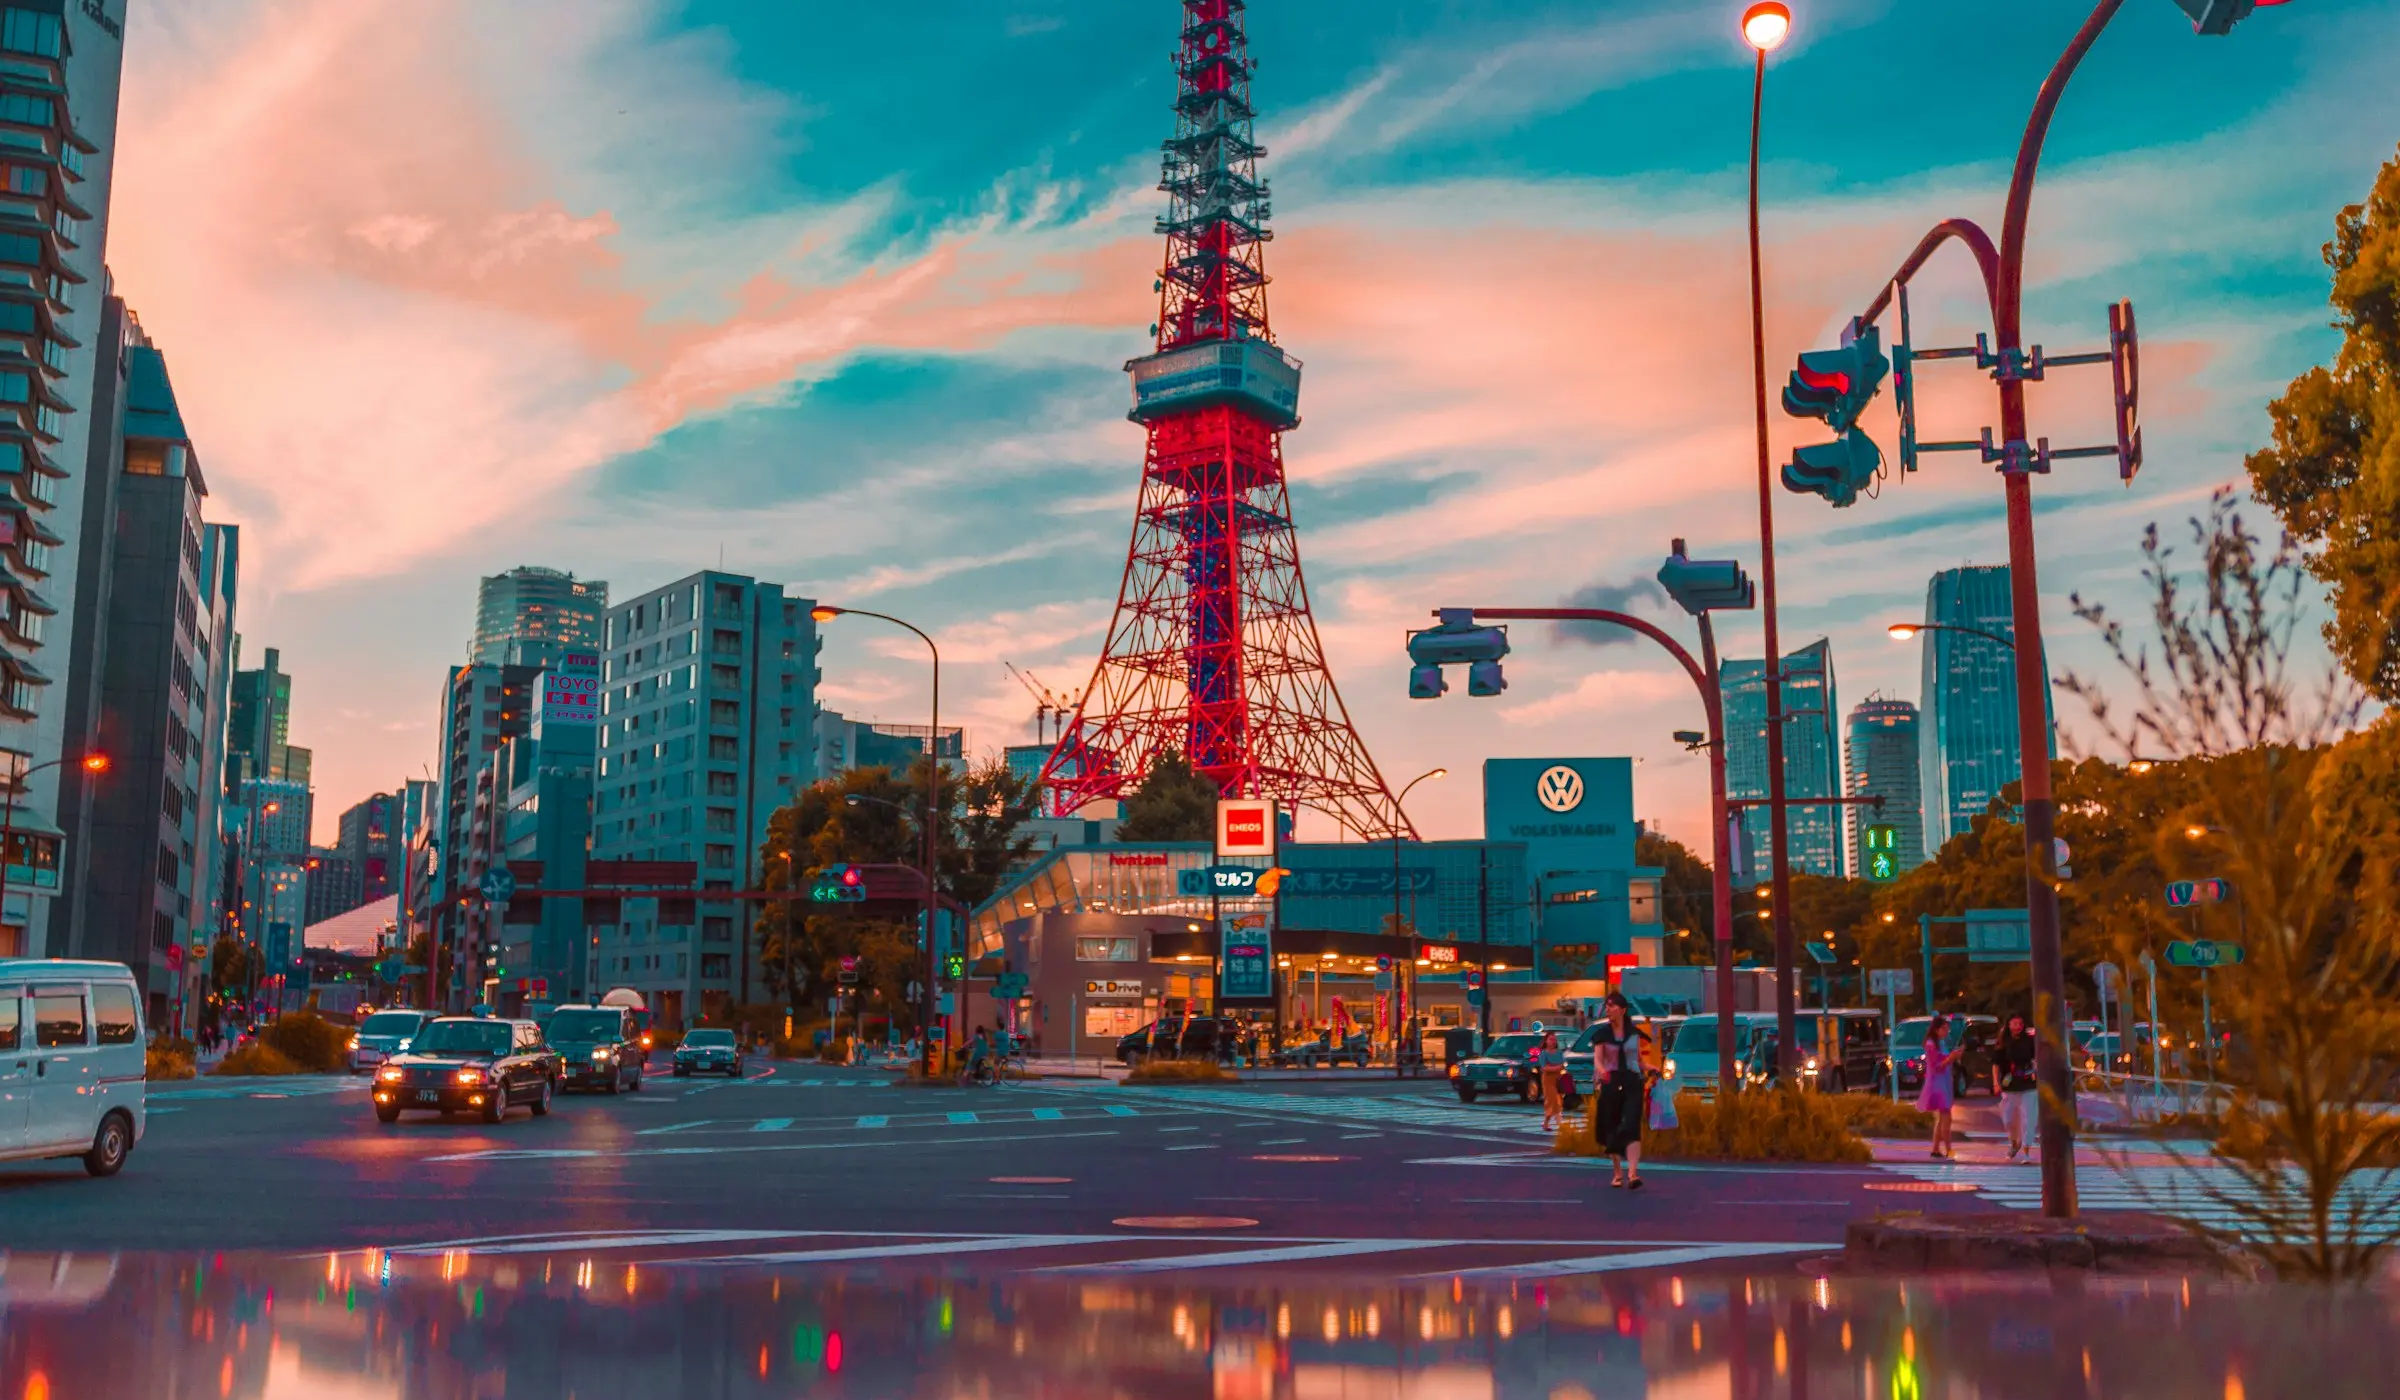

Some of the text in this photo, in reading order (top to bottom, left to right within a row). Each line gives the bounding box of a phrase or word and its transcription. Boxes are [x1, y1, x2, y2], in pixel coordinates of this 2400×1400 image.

[1228, 823, 1262, 833] ENEOS
[1508, 823, 1616, 837] VOLKSWAGEN
[1214, 872, 1254, 887] セルフ
[1429, 946, 1456, 962] ENEOS
[1087, 982, 1140, 992] Dr. Drive
